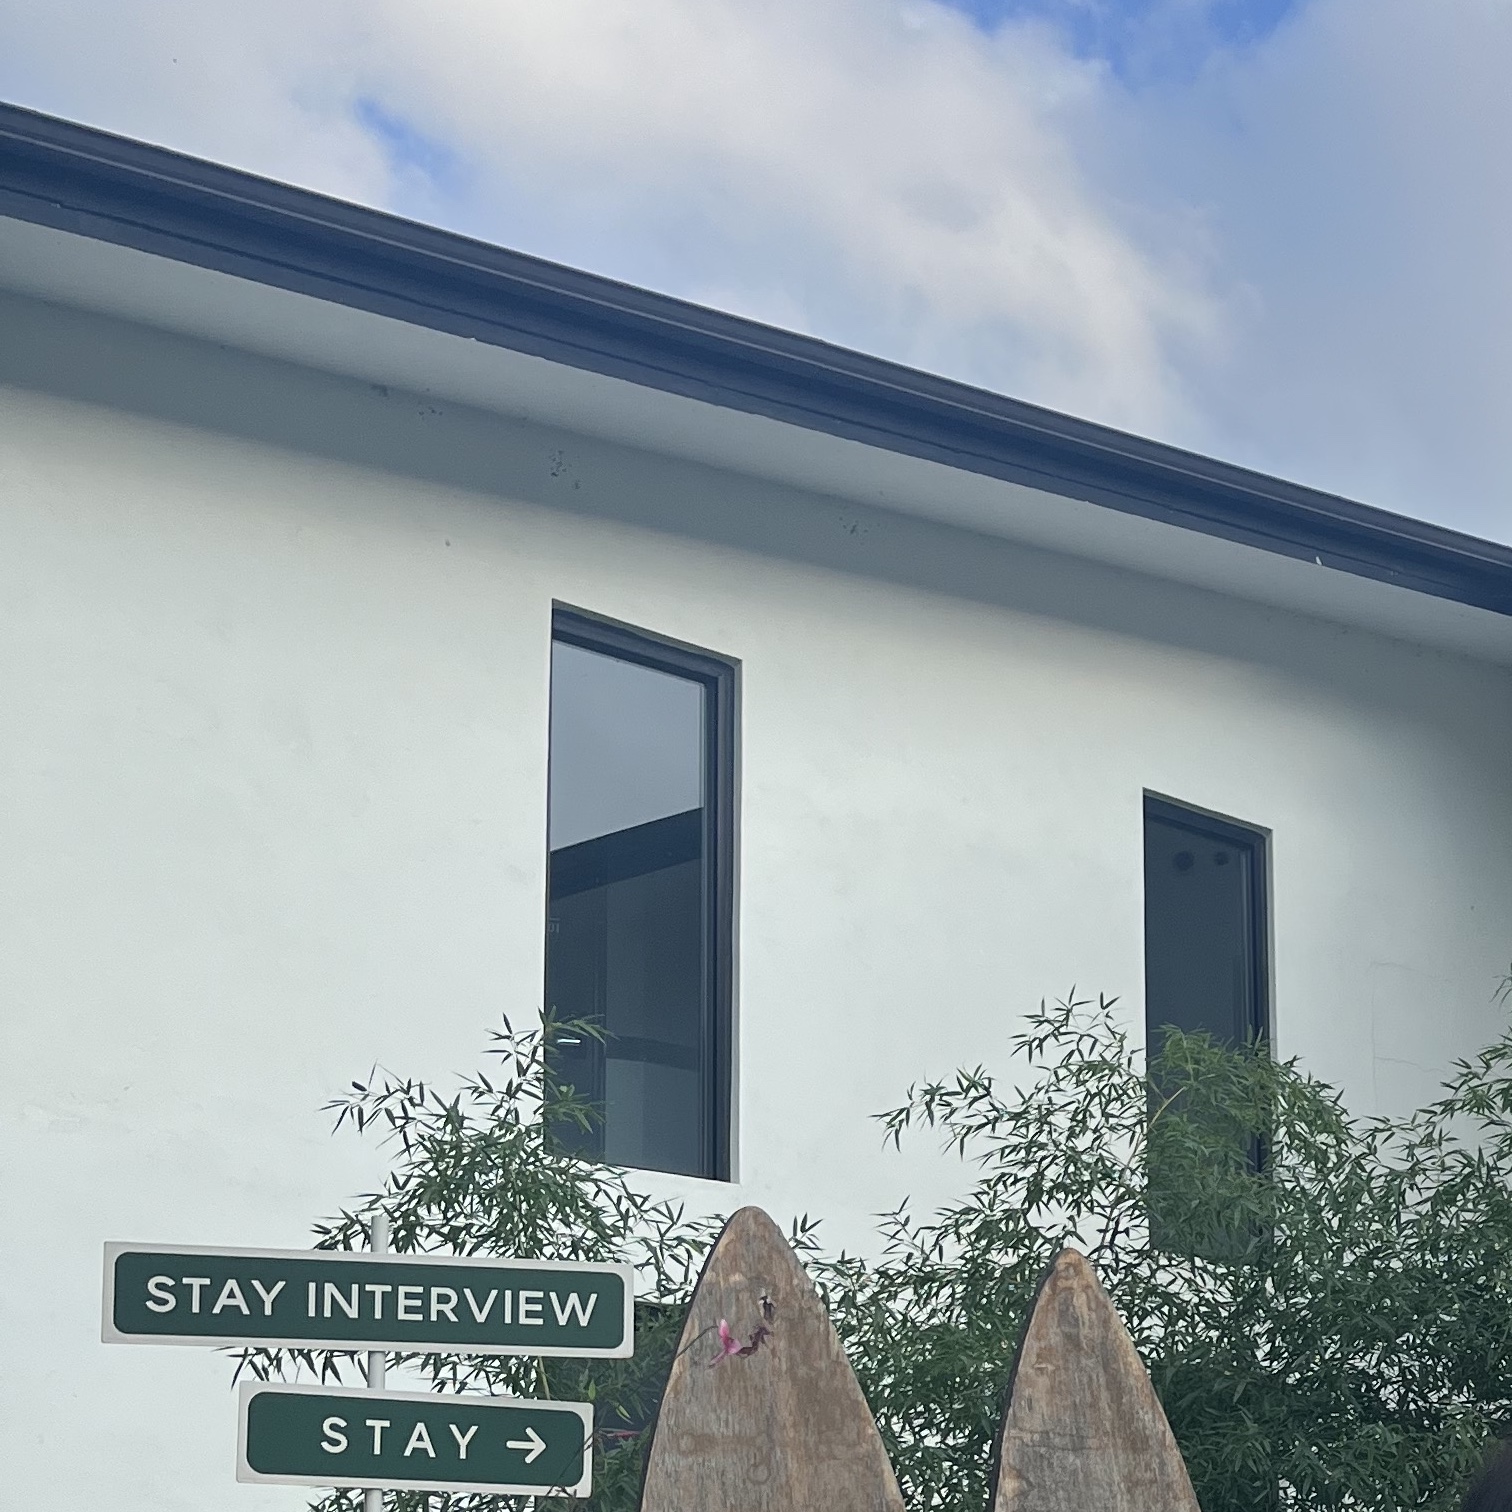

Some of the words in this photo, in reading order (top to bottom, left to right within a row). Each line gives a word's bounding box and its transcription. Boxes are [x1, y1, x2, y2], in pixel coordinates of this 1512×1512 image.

[145, 1276, 286, 1316] STAY
[307, 1281, 598, 1327] INTERVIEW
[320, 1416, 478, 1460] STAY
